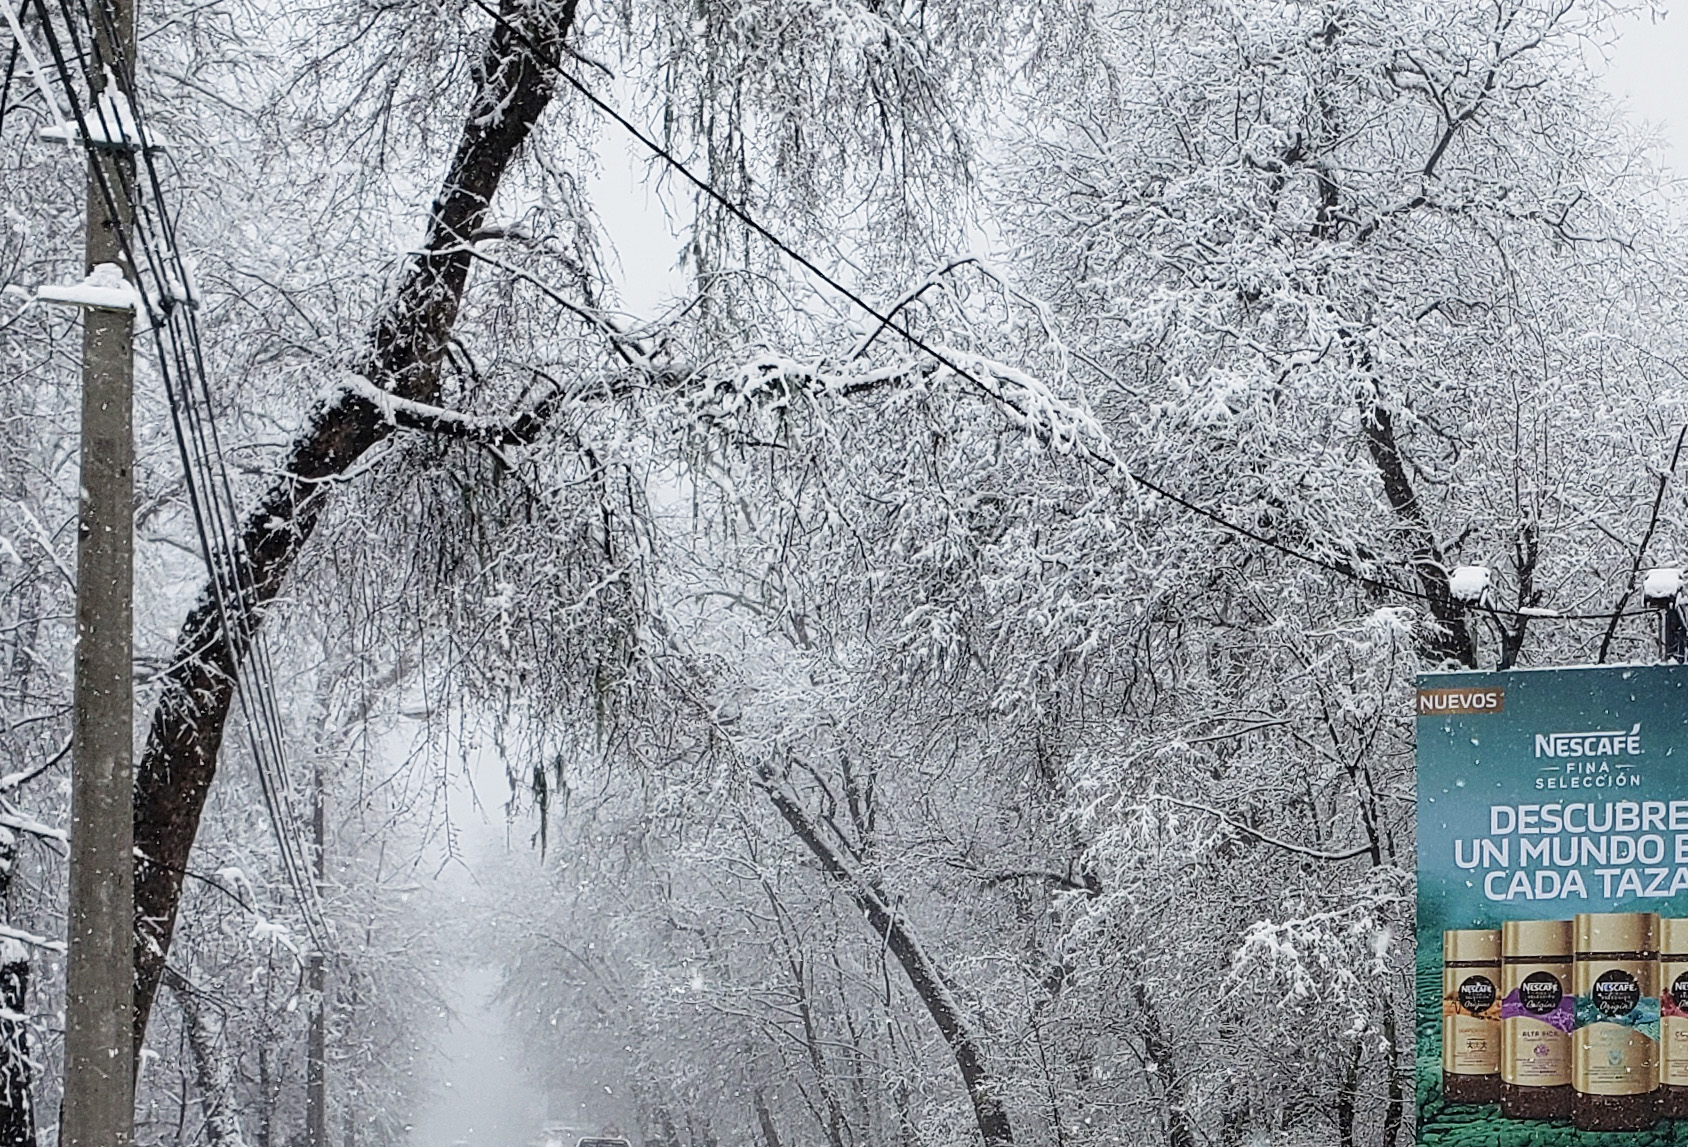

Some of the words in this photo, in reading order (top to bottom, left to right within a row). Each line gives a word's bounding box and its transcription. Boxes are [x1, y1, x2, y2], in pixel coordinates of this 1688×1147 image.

[1420, 692, 1497, 710] NUEVOS
[1535, 723, 1641, 758] NESCAFÉ
[1566, 762, 1610, 774] FINA
[1535, 773, 1641, 789] SELECCIÓN
[1455, 839, 1509, 869] UN
[1520, 835, 1664, 867] MUNDO
[1484, 869, 1588, 900] CADA
